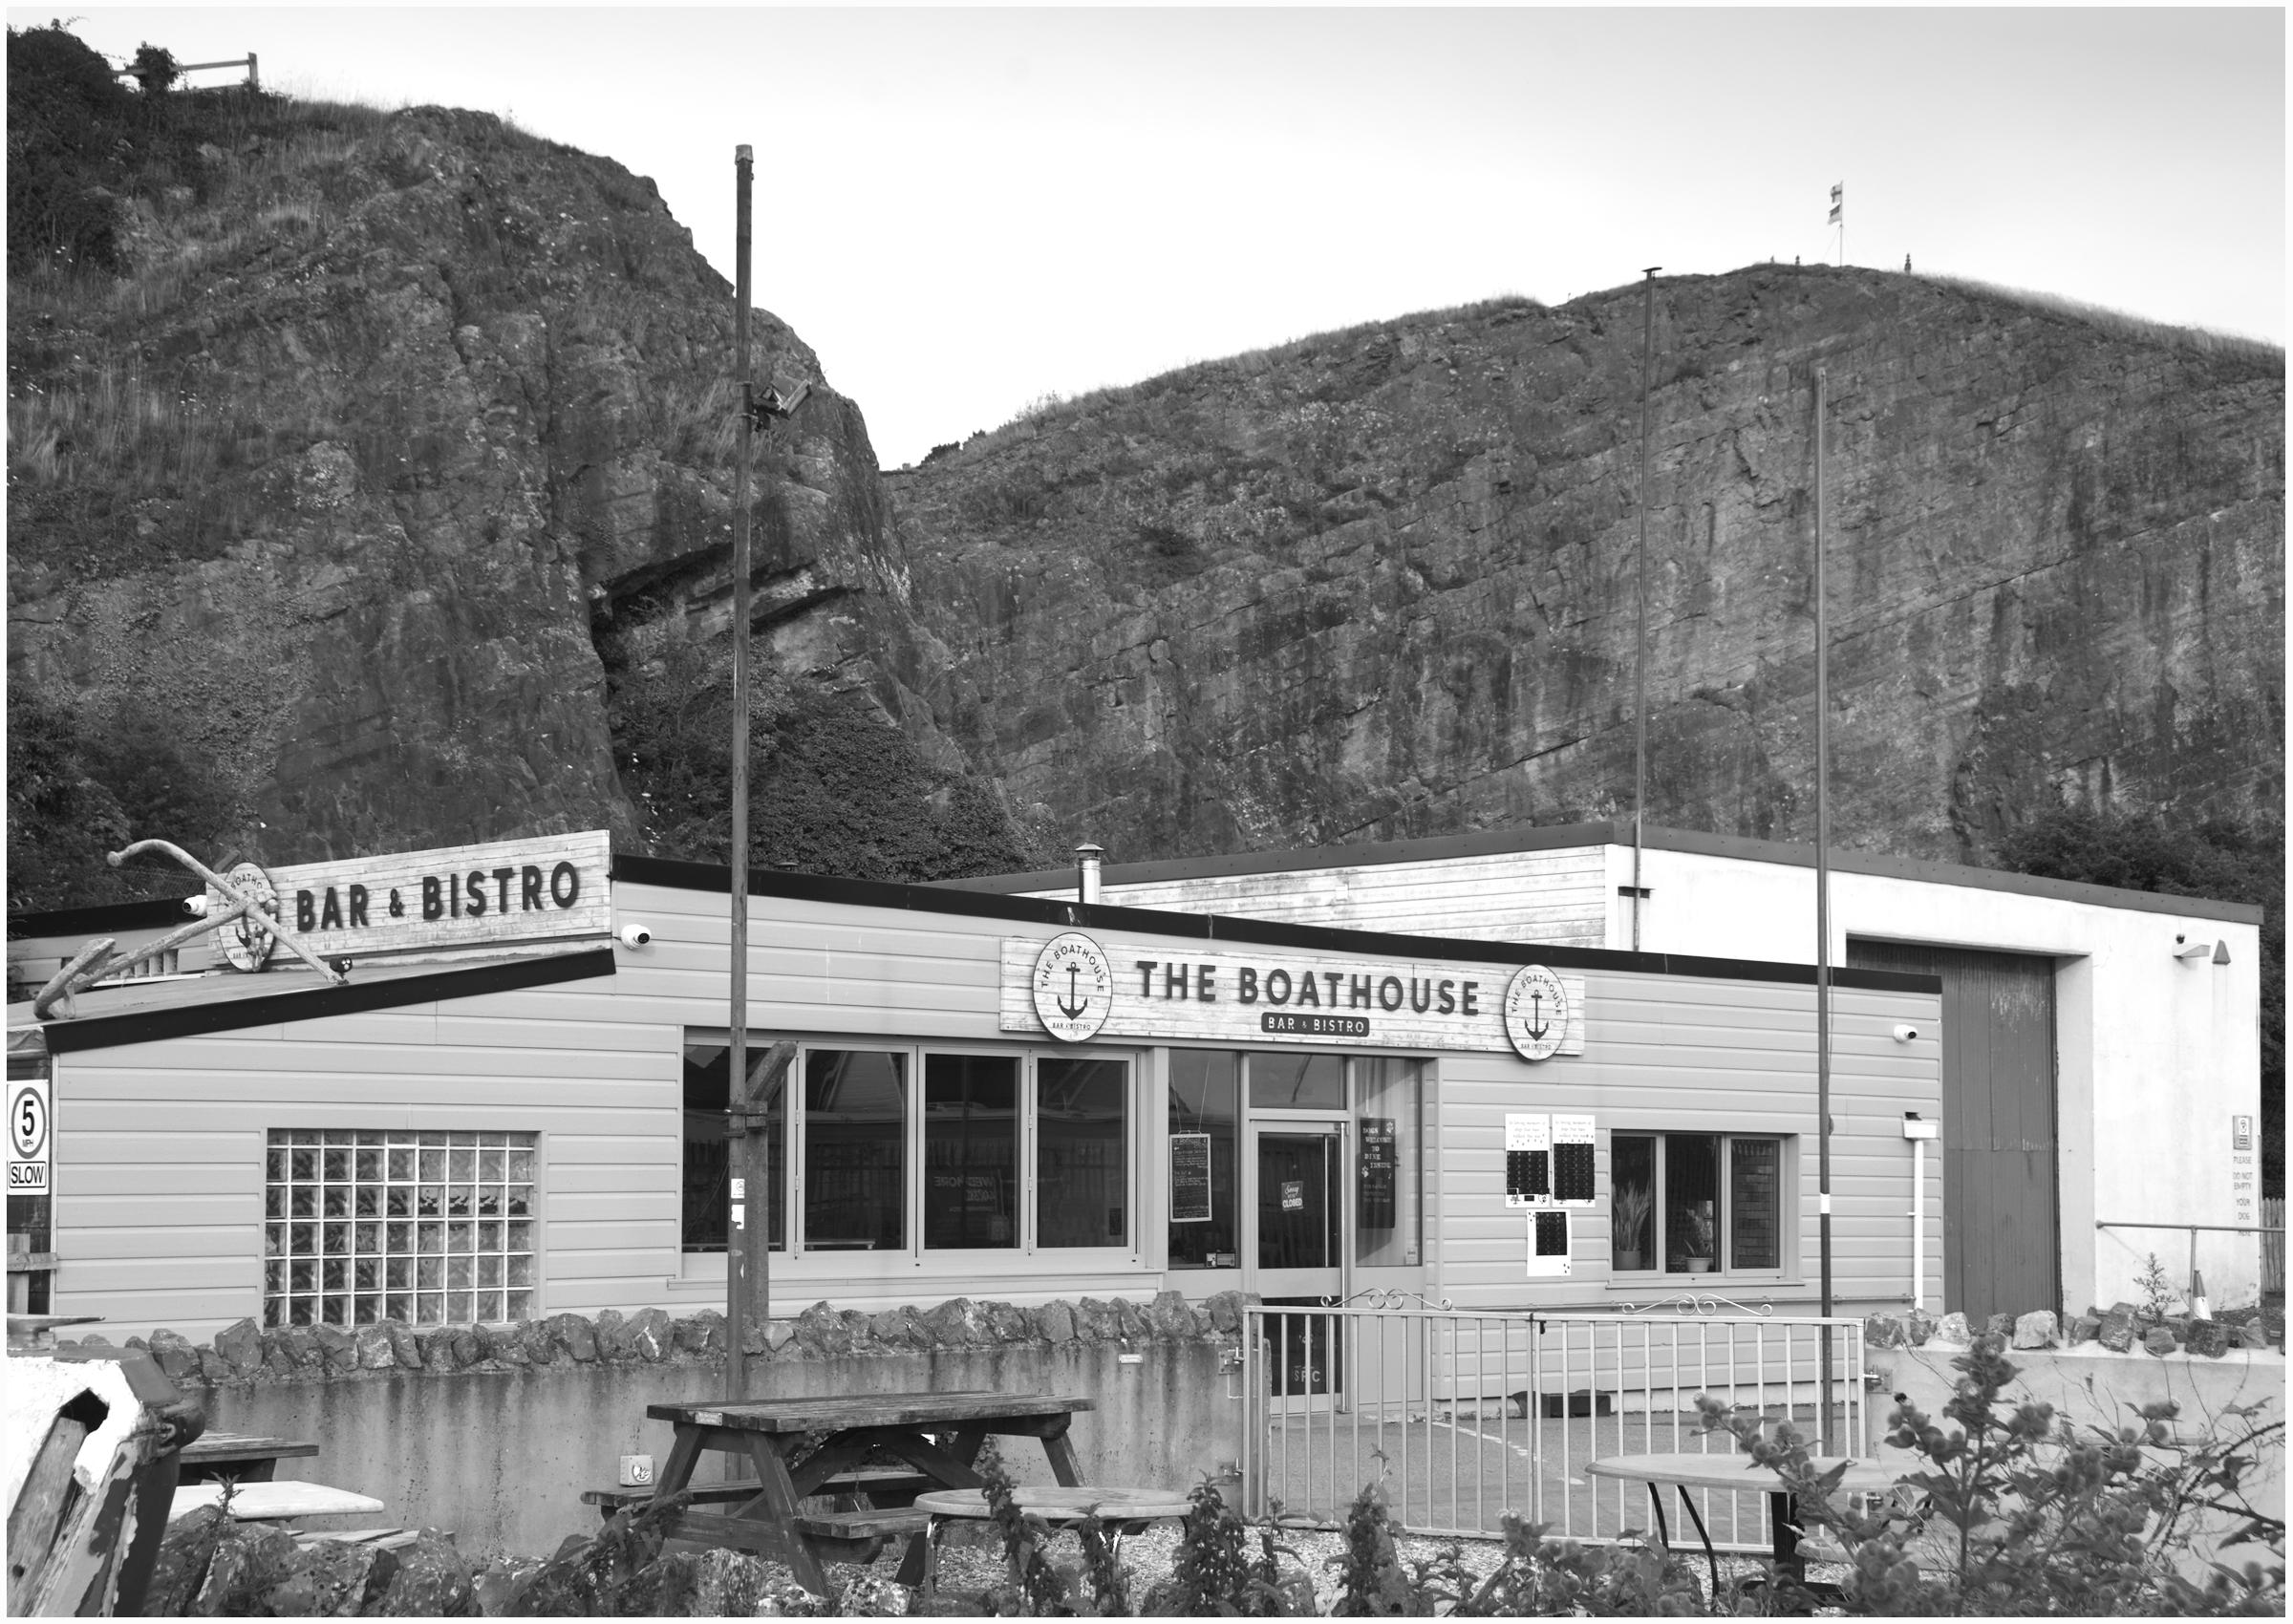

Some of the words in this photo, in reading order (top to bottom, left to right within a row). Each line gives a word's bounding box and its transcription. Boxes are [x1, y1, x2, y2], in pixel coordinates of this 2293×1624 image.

[297, 884, 369, 932] BAR
[388, 887, 404, 917] &
[423, 861, 577, 920] BISTRO
[1040, 960, 1054, 989] THE
[1053, 944, 1104, 993] BOATHOUSE
[1137, 960, 1216, 1002] THE
[1240, 966, 1480, 1015] BOATHOUSE
[1511, 988, 1522, 1014] THE
[1521, 974, 1563, 1015] BOATHOUSE
[1268, 1016, 1296, 1031] BAR
[1300, 1019, 1308, 1030] &
[1314, 1018, 1365, 1035] BISTRO
[22, 1100, 35, 1137] 5
[22, 1139, 34, 1148] MPH
[11, 1165, 44, 1185] SLOW
